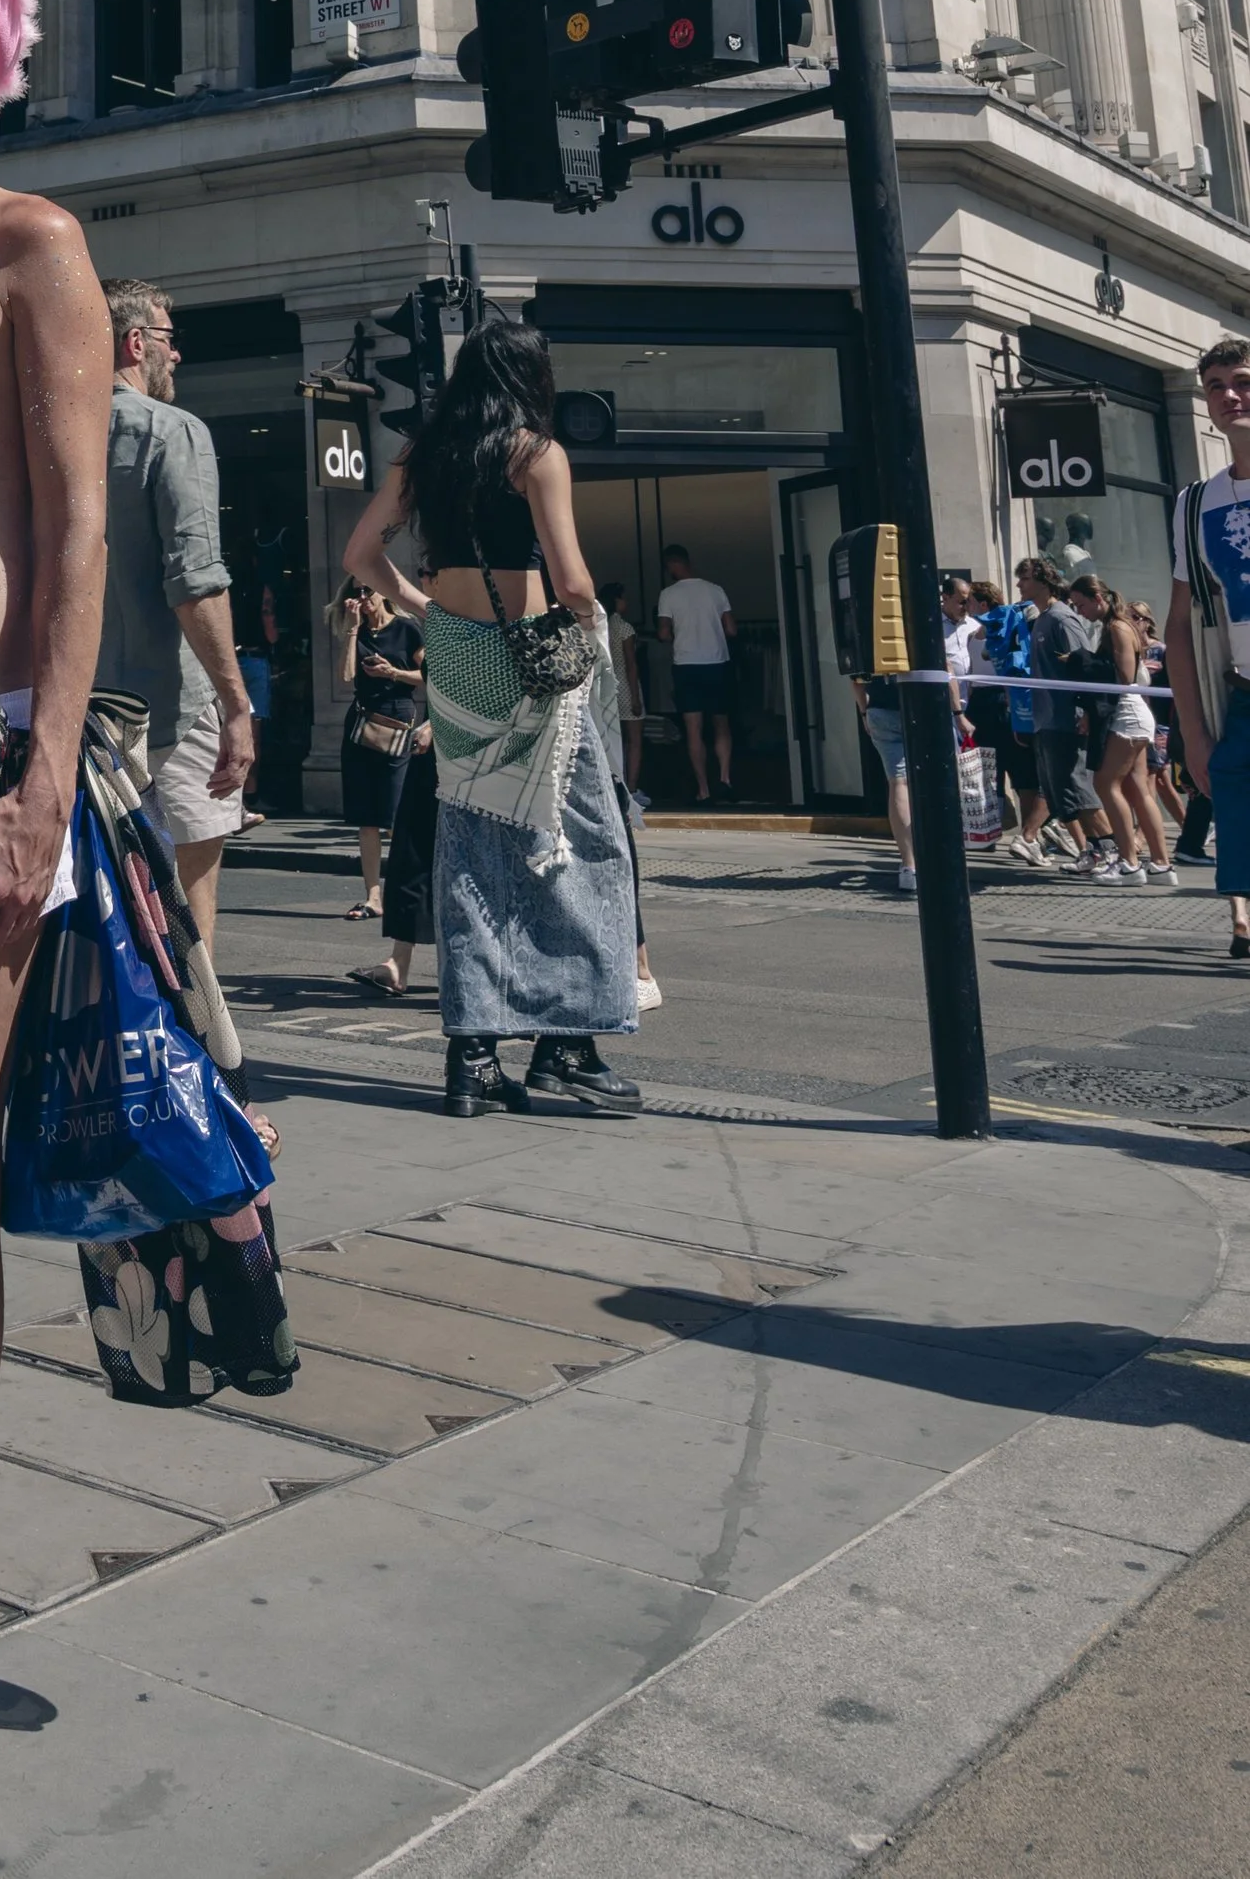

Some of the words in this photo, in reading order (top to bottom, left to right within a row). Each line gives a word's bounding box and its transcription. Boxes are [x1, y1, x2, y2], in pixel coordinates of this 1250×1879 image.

[318, 0, 366, 22] STREET
[651, 181, 744, 245] alo
[1095, 254, 1125, 311] alo
[325, 429, 366, 480] alo
[1020, 439, 1092, 488] alo
